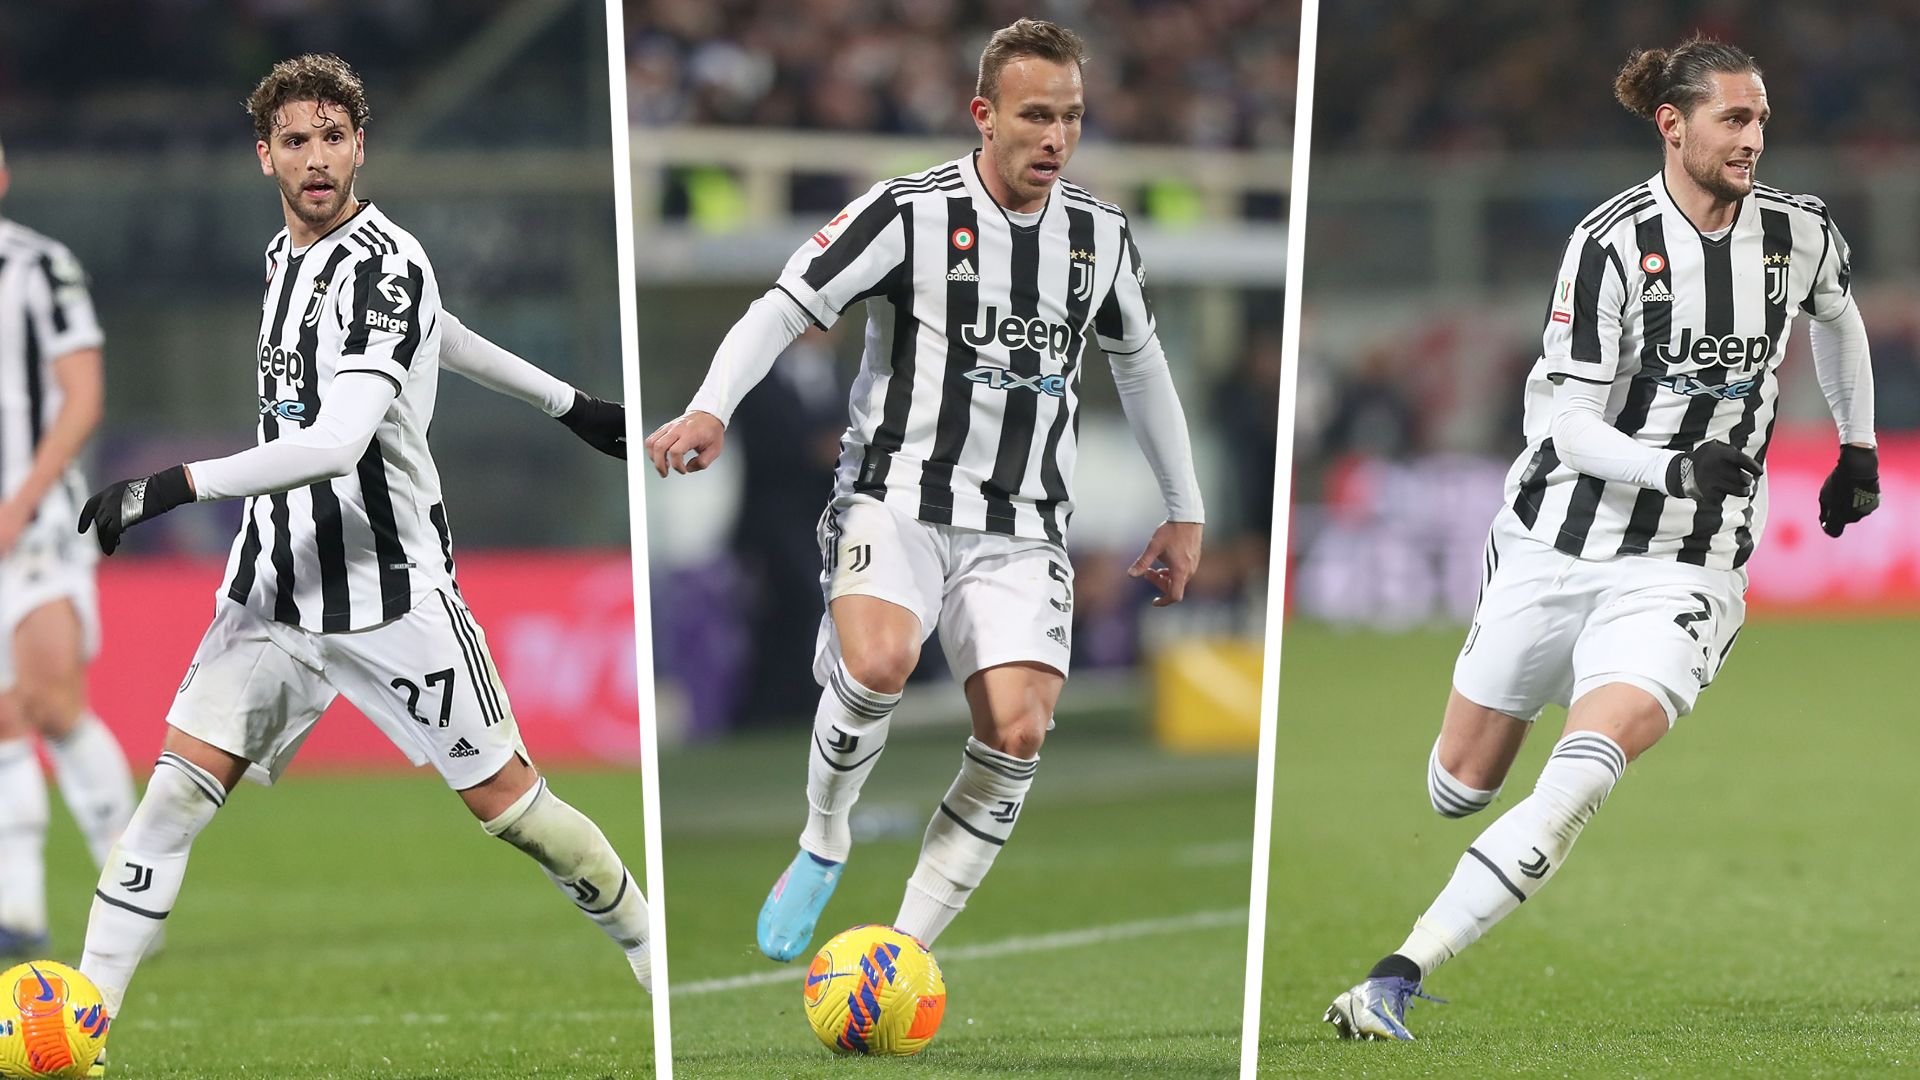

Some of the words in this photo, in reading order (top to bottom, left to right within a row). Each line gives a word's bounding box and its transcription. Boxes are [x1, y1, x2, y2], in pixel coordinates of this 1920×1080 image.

[946, 273, 980, 282] adidas
[1640, 293, 1675, 302] adidas
[961, 305, 1071, 363] Jeep
[1657, 328, 1771, 374] Jeep
[257, 333, 304, 387] eep
[390, 667, 456, 728] 27
[449, 748, 480, 758] adidas
